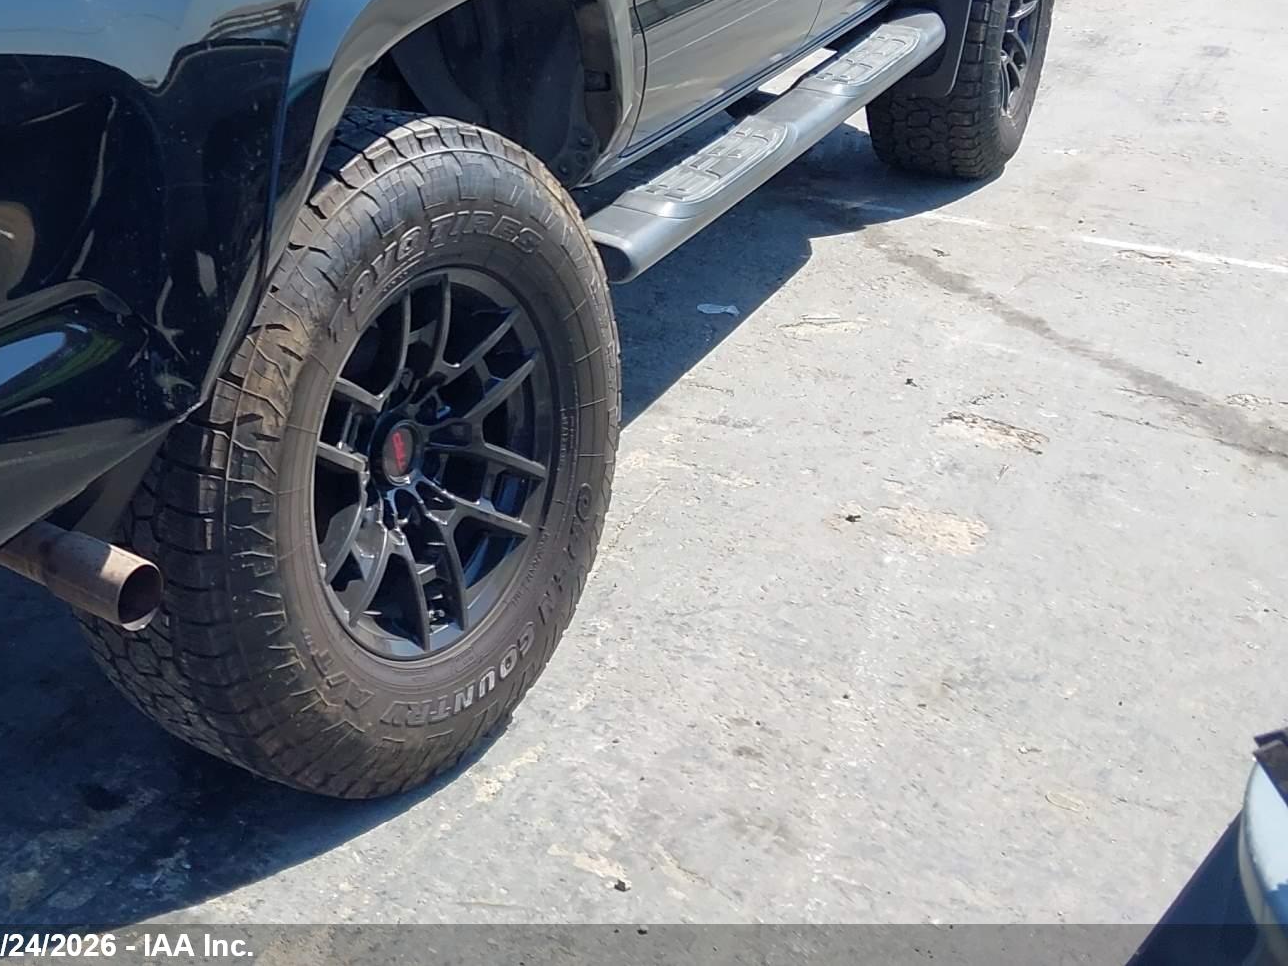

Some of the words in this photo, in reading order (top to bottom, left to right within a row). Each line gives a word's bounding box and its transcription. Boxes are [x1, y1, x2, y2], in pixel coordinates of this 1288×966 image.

[328, 225, 423, 344] TOYO
[429, 209, 545, 254] TIRES
[379, 620, 536, 727] COUNTRY
